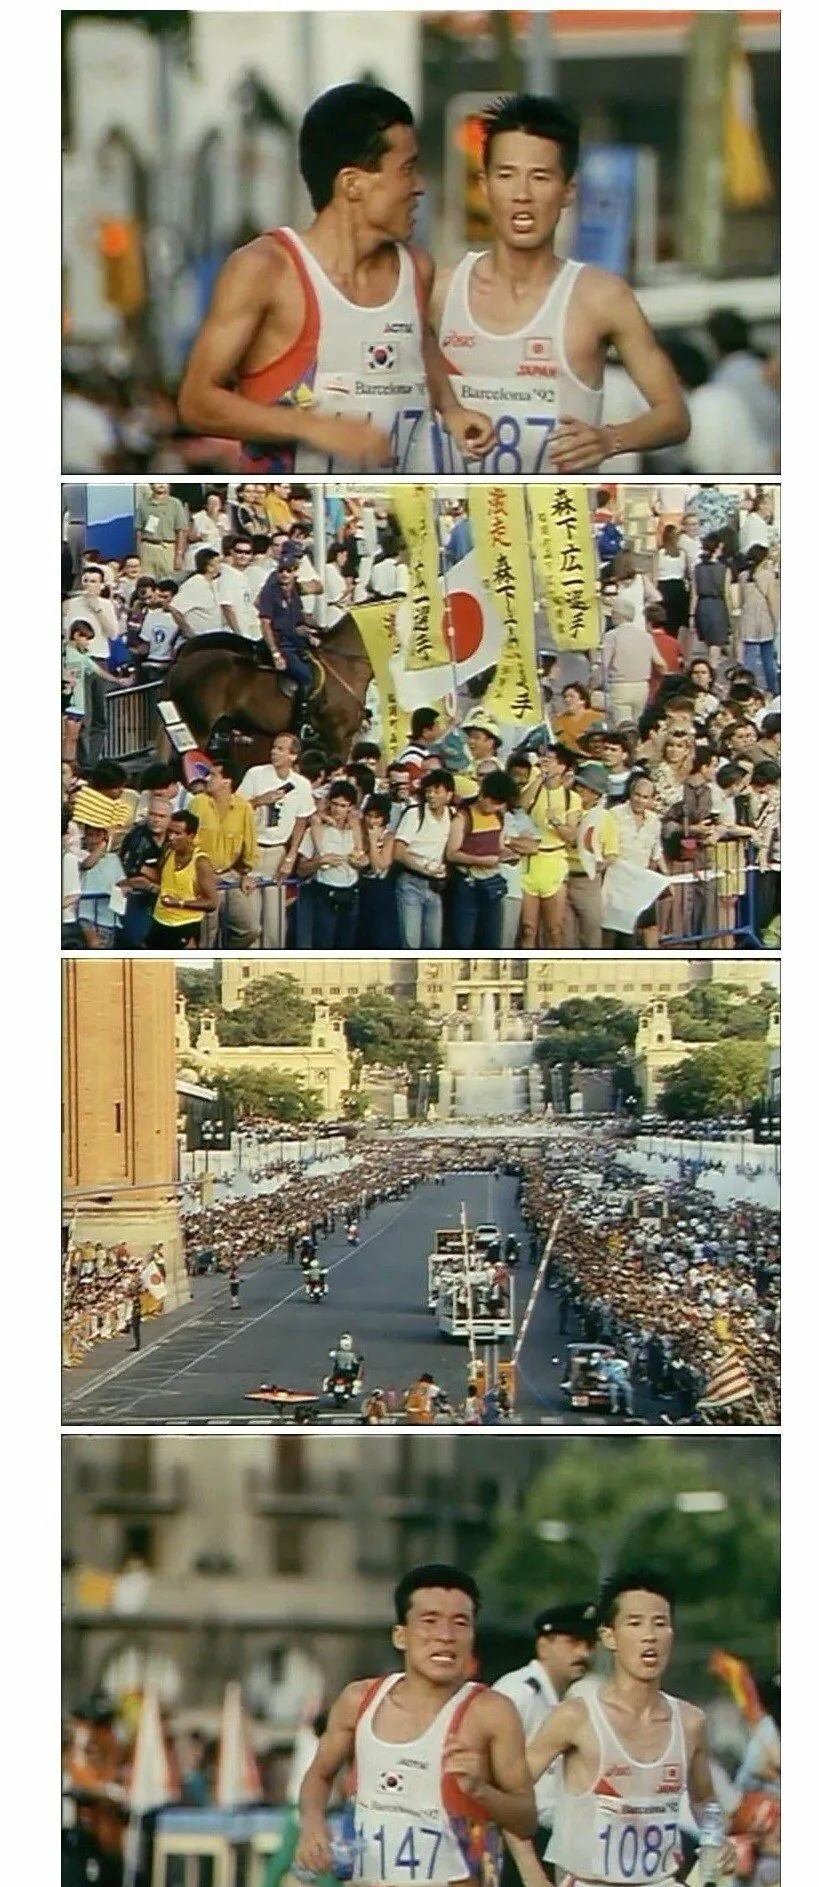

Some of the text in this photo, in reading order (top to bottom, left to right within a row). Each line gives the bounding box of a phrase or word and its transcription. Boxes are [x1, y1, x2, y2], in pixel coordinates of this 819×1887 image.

[516, 364, 557, 377] JAPAN
[461, 385, 531, 401] Barcelona
[358, 1822, 442, 1880] 1147
[599, 1823, 678, 1878] 1087
